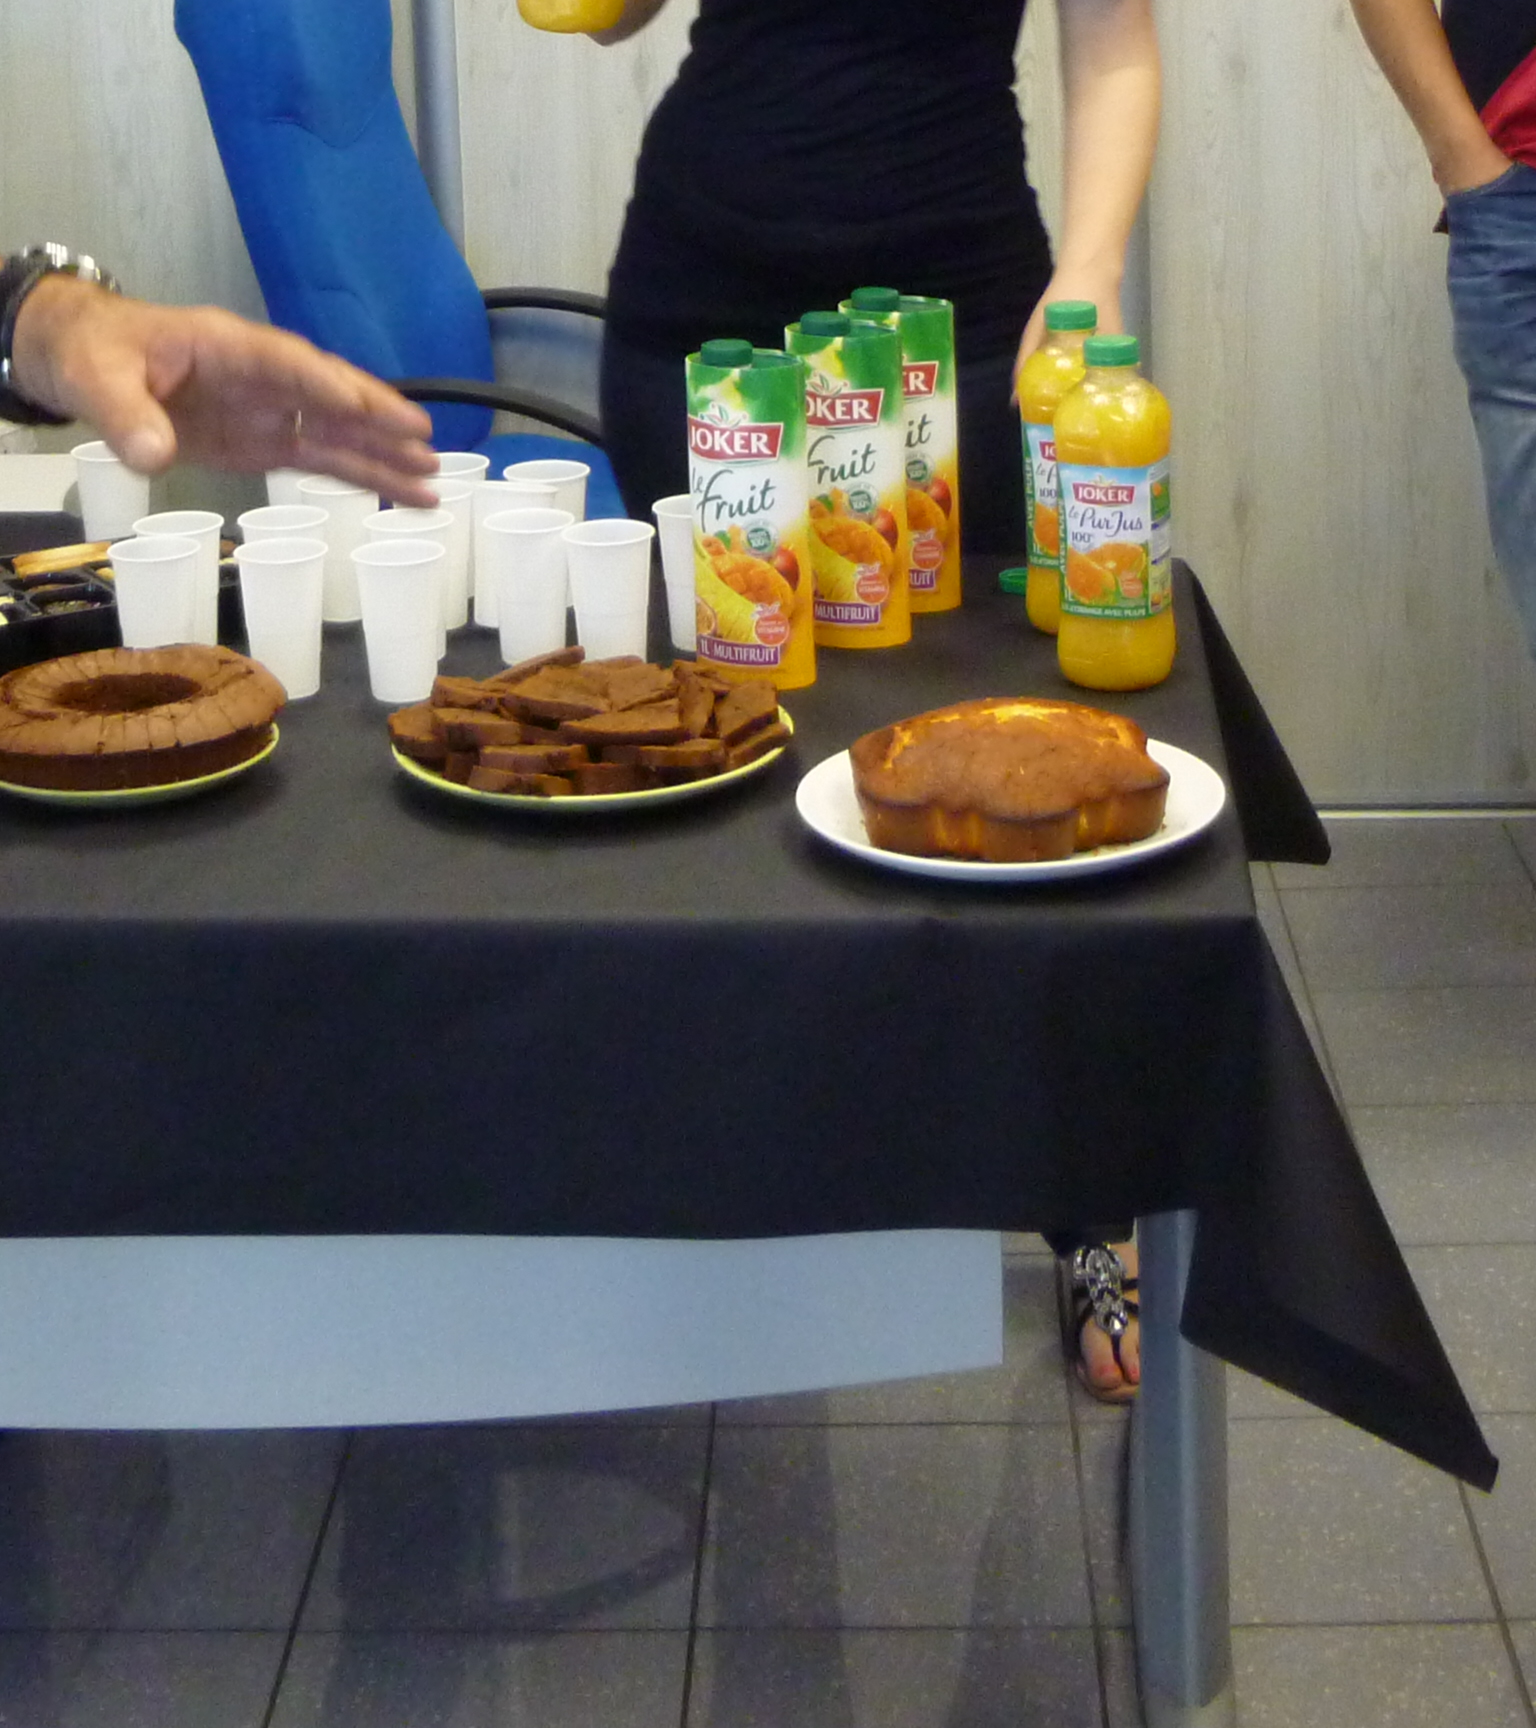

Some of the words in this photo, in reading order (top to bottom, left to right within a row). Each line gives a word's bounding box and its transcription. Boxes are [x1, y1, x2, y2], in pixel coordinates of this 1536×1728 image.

[691, 429, 773, 456] JOKER
[1078, 485, 1130, 502] JOKER
[815, 602, 878, 621] MULTIFRUIT
[700, 638, 710, 655] 1L
[714, 641, 776, 663] MULTIFRUIT
